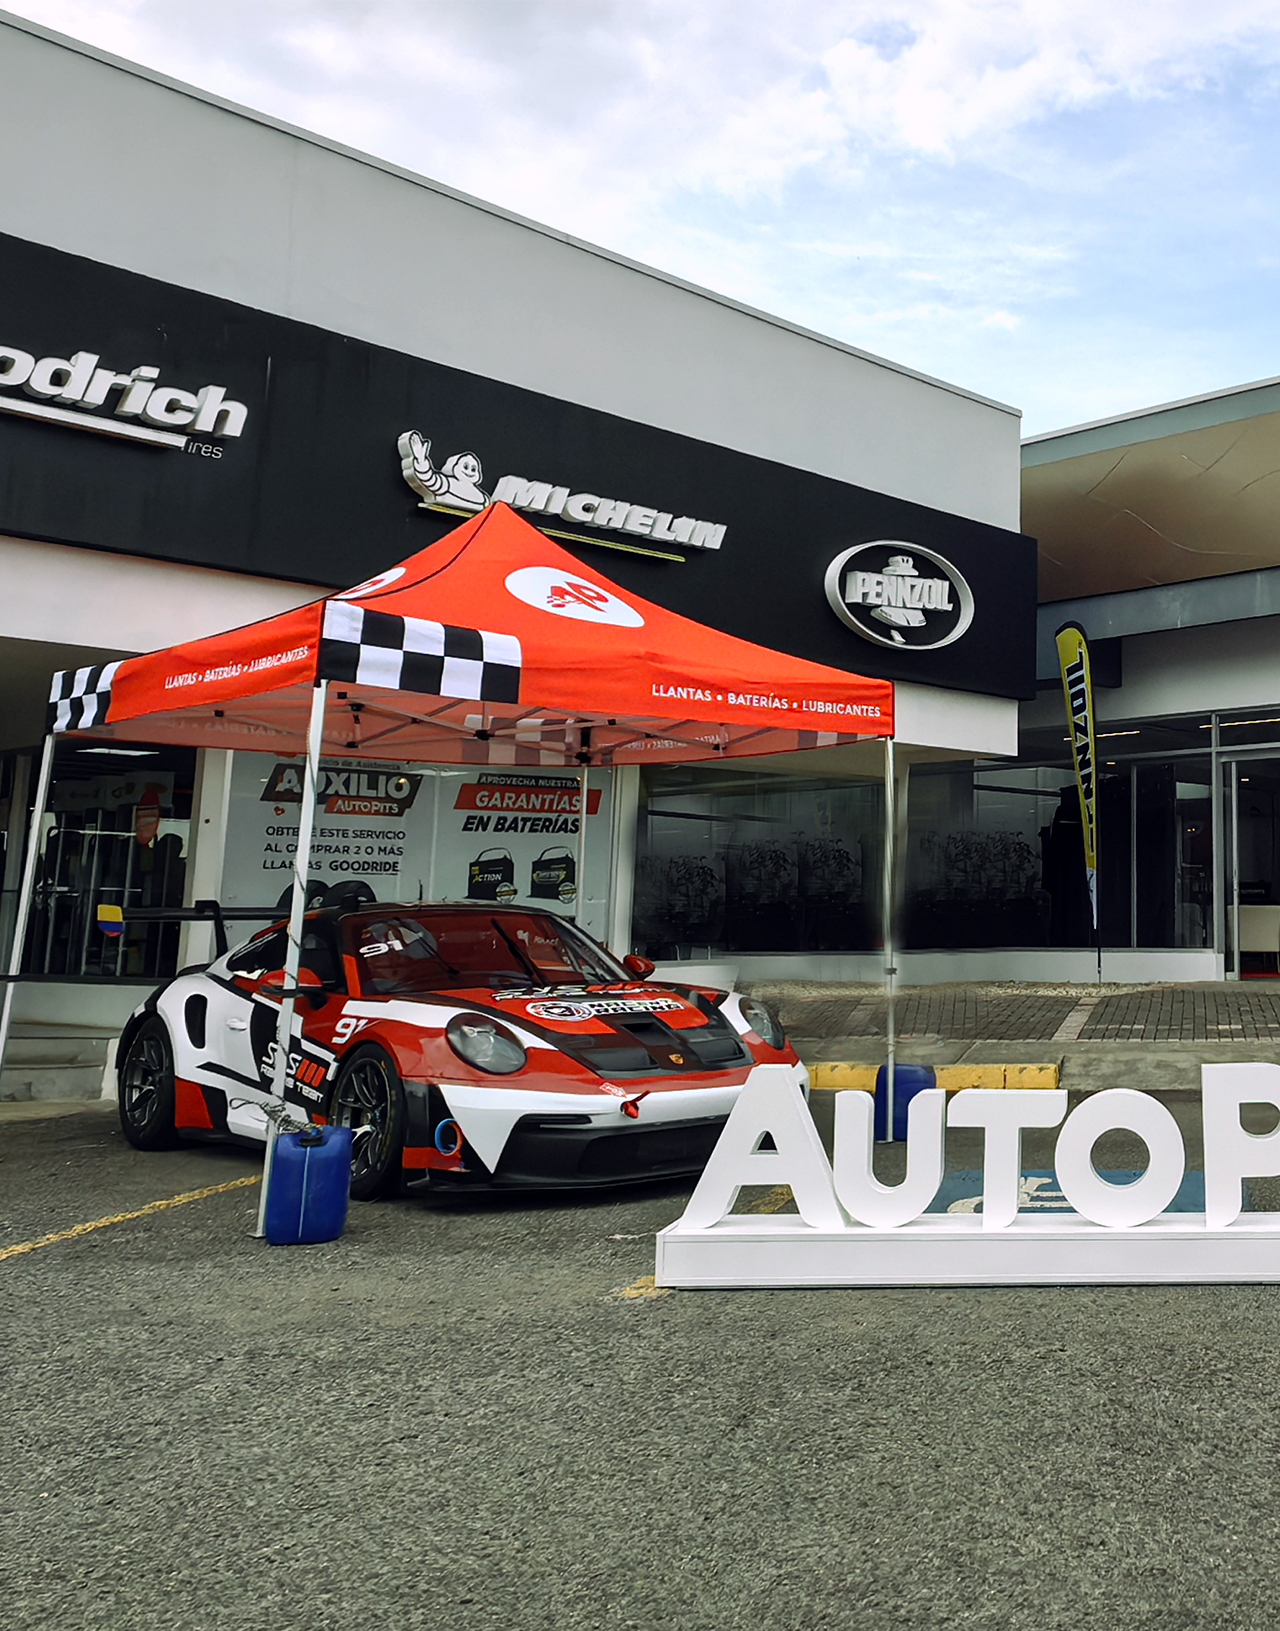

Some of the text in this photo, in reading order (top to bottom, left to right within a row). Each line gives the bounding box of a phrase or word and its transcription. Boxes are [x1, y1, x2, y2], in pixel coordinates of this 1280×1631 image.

[491, 475, 727, 550] MICHELIN
[845, 571, 953, 612] PENNZOIL
[165, 646, 309, 690] LLANTAS BATERÍAS LUBRICANTES
[652, 684, 881, 718] LLANTAS BATERÍAS LUBRICANTES
[480, 776, 536, 786] APROVECHA
[476, 791, 581, 811] GARANTÍAS
[320, 828, 349, 838] ESTE
[352, 830, 406, 840] SERVICIO
[462, 814, 580, 834] EN BATERÍAS
[264, 843, 282, 853] AL
[354, 846, 361, 855] 2
[378, 844, 404, 856] MÁS
[329, 860, 400, 872] GOODRIDE
[359, 939, 403, 958] 91
[331, 1017, 369, 1044] 91
